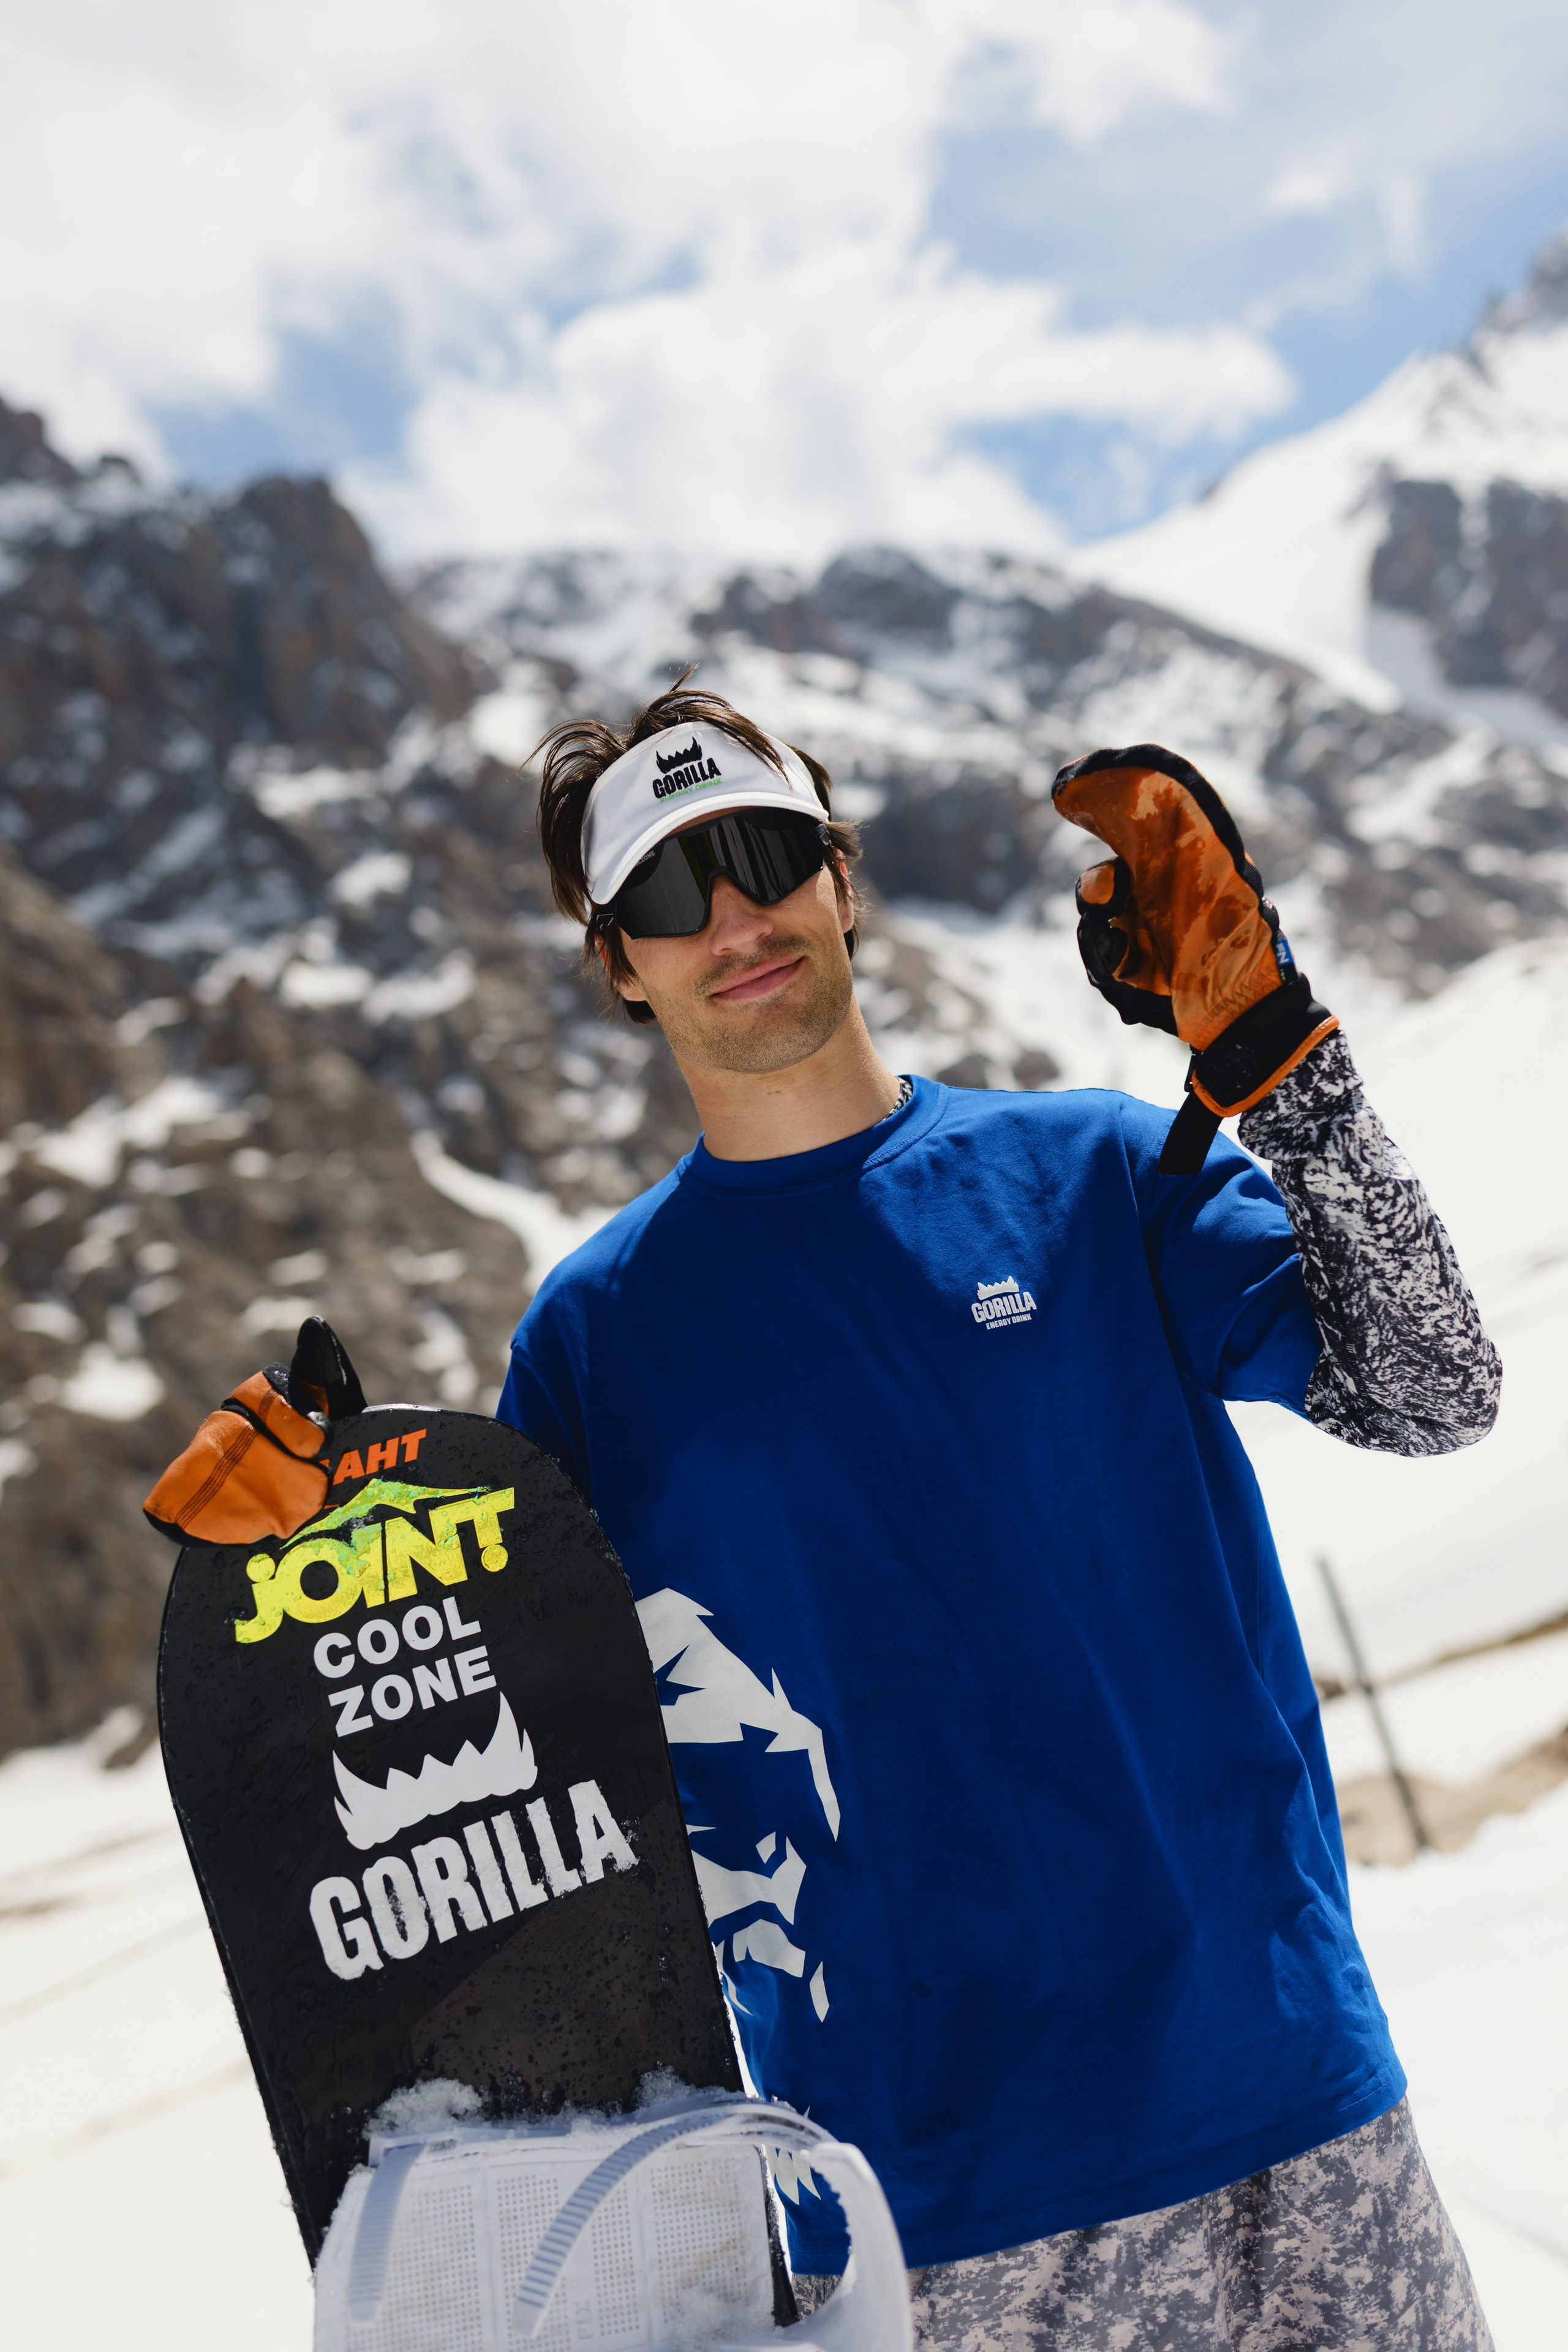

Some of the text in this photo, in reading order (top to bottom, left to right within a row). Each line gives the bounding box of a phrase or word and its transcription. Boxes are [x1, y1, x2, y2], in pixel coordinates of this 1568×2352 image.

[652, 758, 722, 799] GORILLA
[971, 1291, 1037, 1323] GORILLA
[986, 1313, 1032, 1330] ENERGY DRINK
[314, 1596, 481, 1678] COOL
[328, 1645, 497, 1738] ZONE
[309, 1779, 639, 1981] GORILLA
